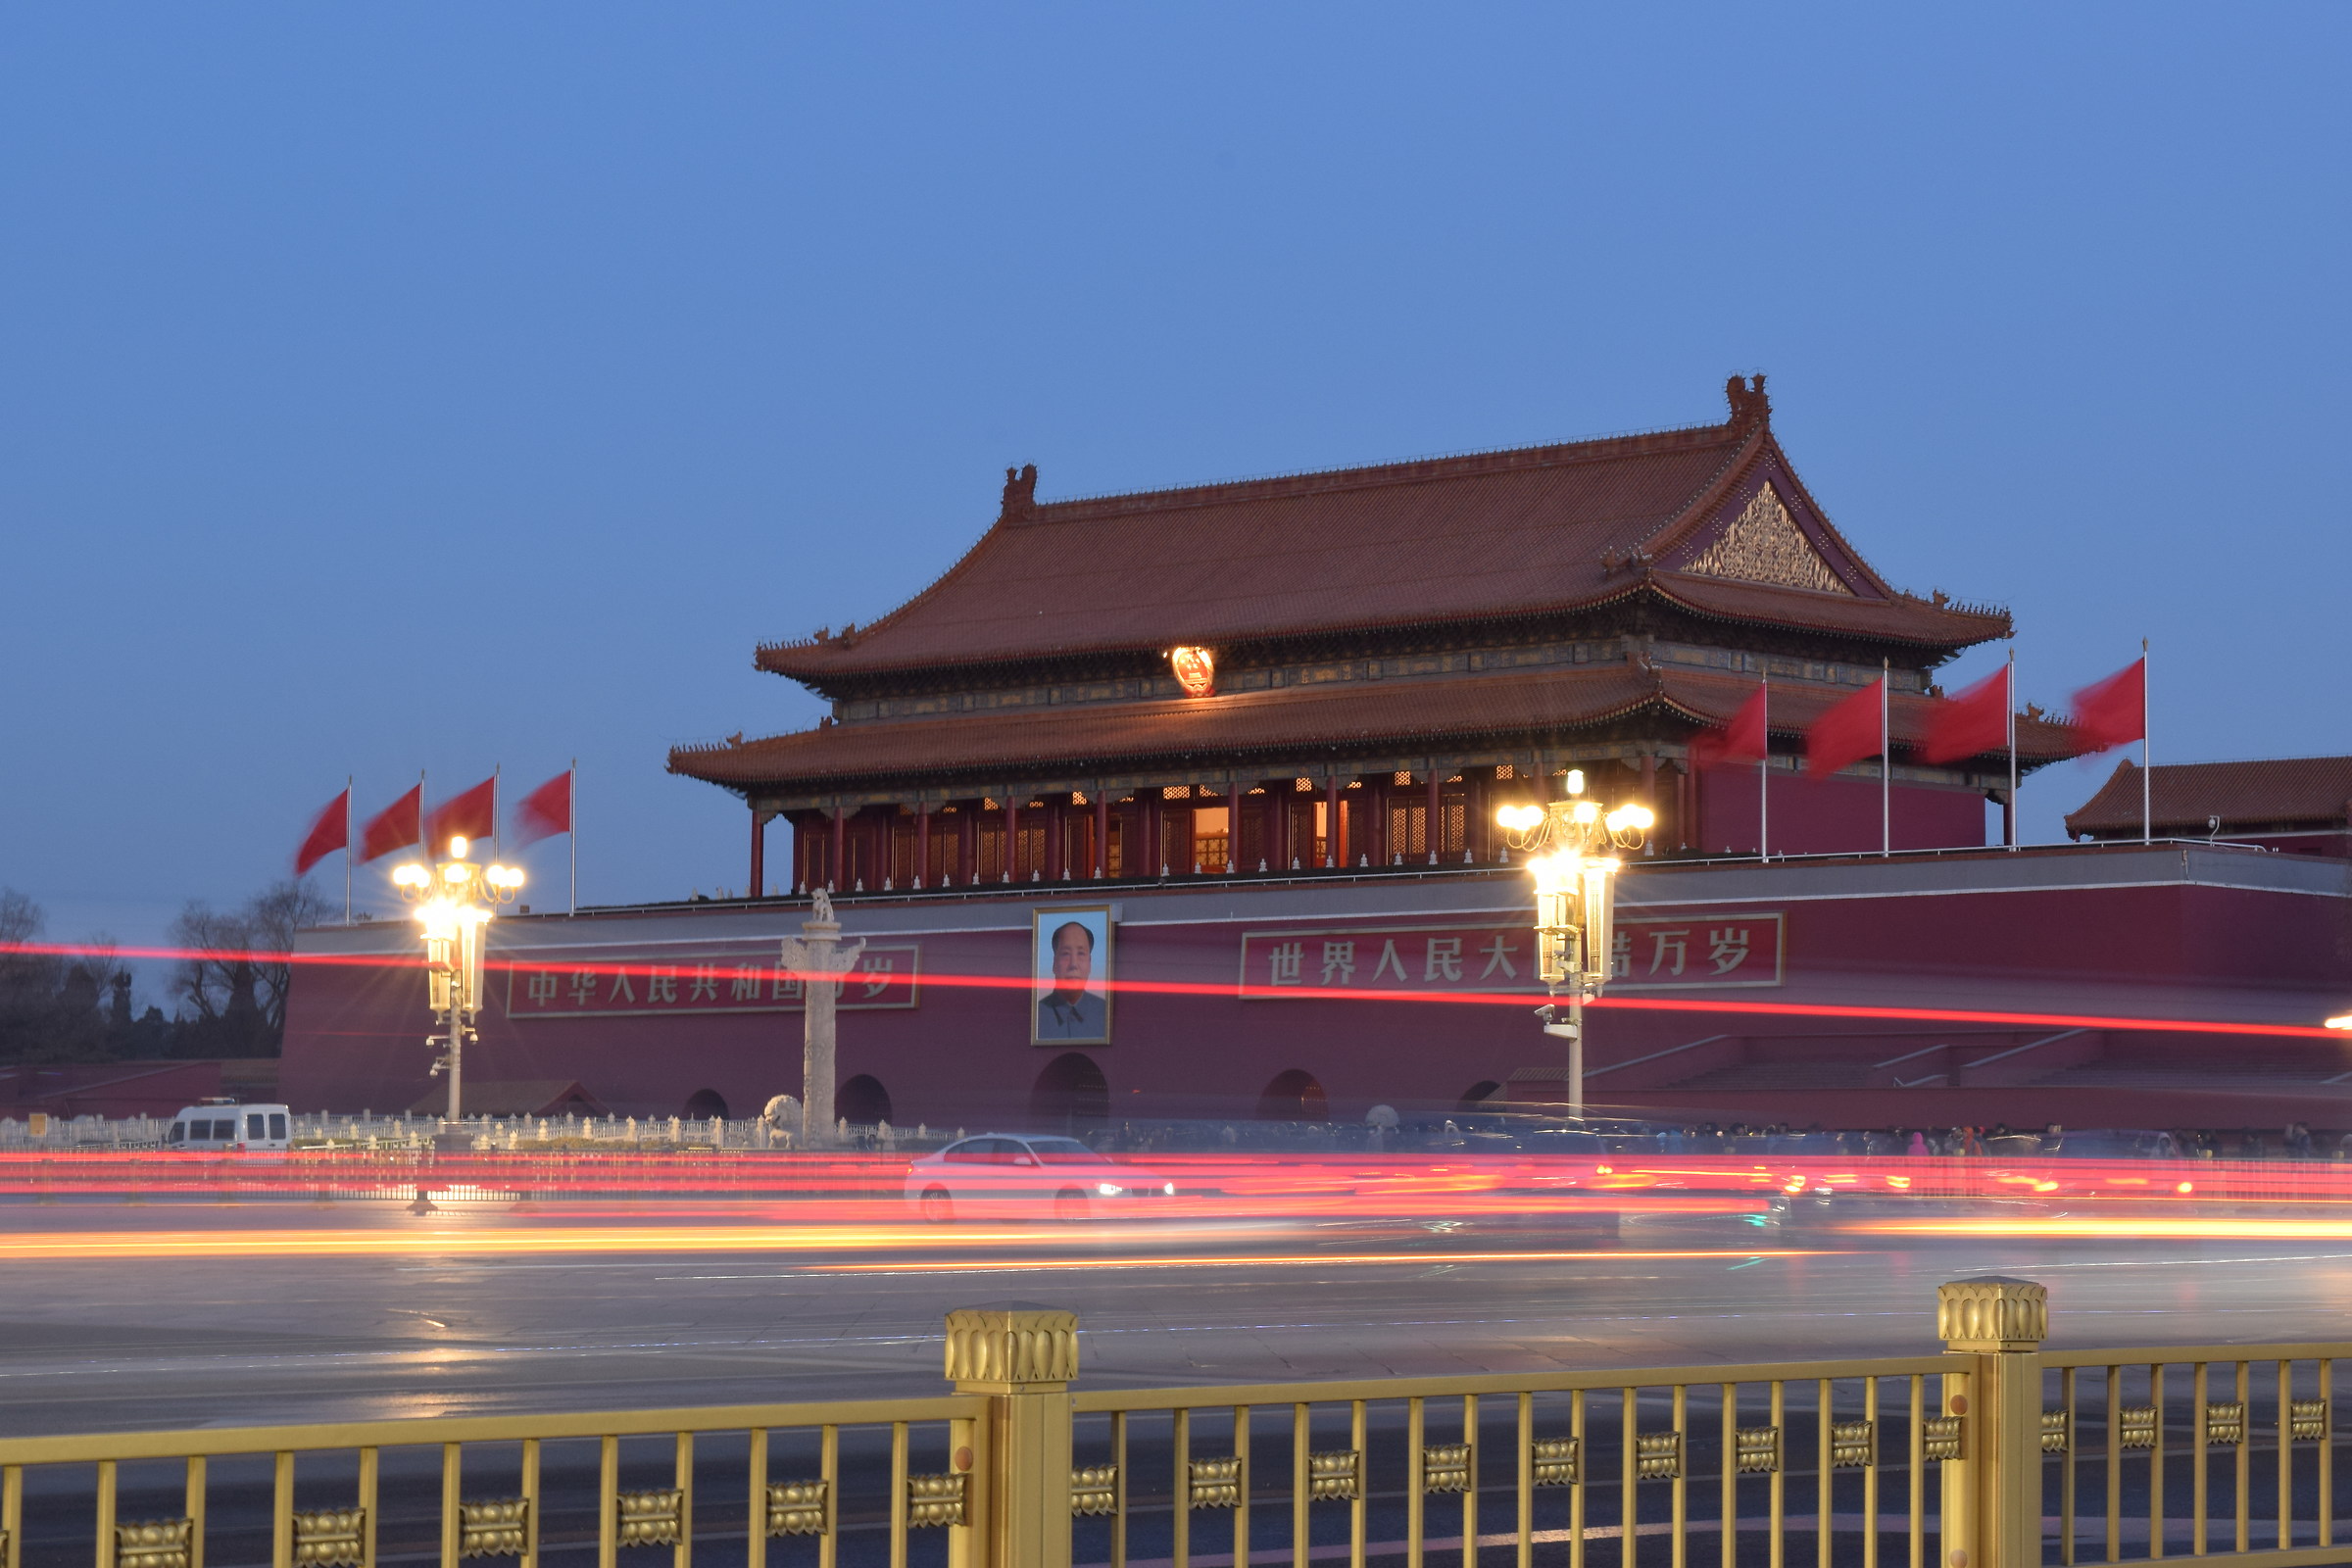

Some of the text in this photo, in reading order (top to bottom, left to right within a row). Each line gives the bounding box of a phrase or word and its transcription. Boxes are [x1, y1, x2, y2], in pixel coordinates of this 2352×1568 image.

[527, 956, 893, 1007] 中华人民共和国岁
[1268, 927, 1749, 987] 世界人民大万岁
